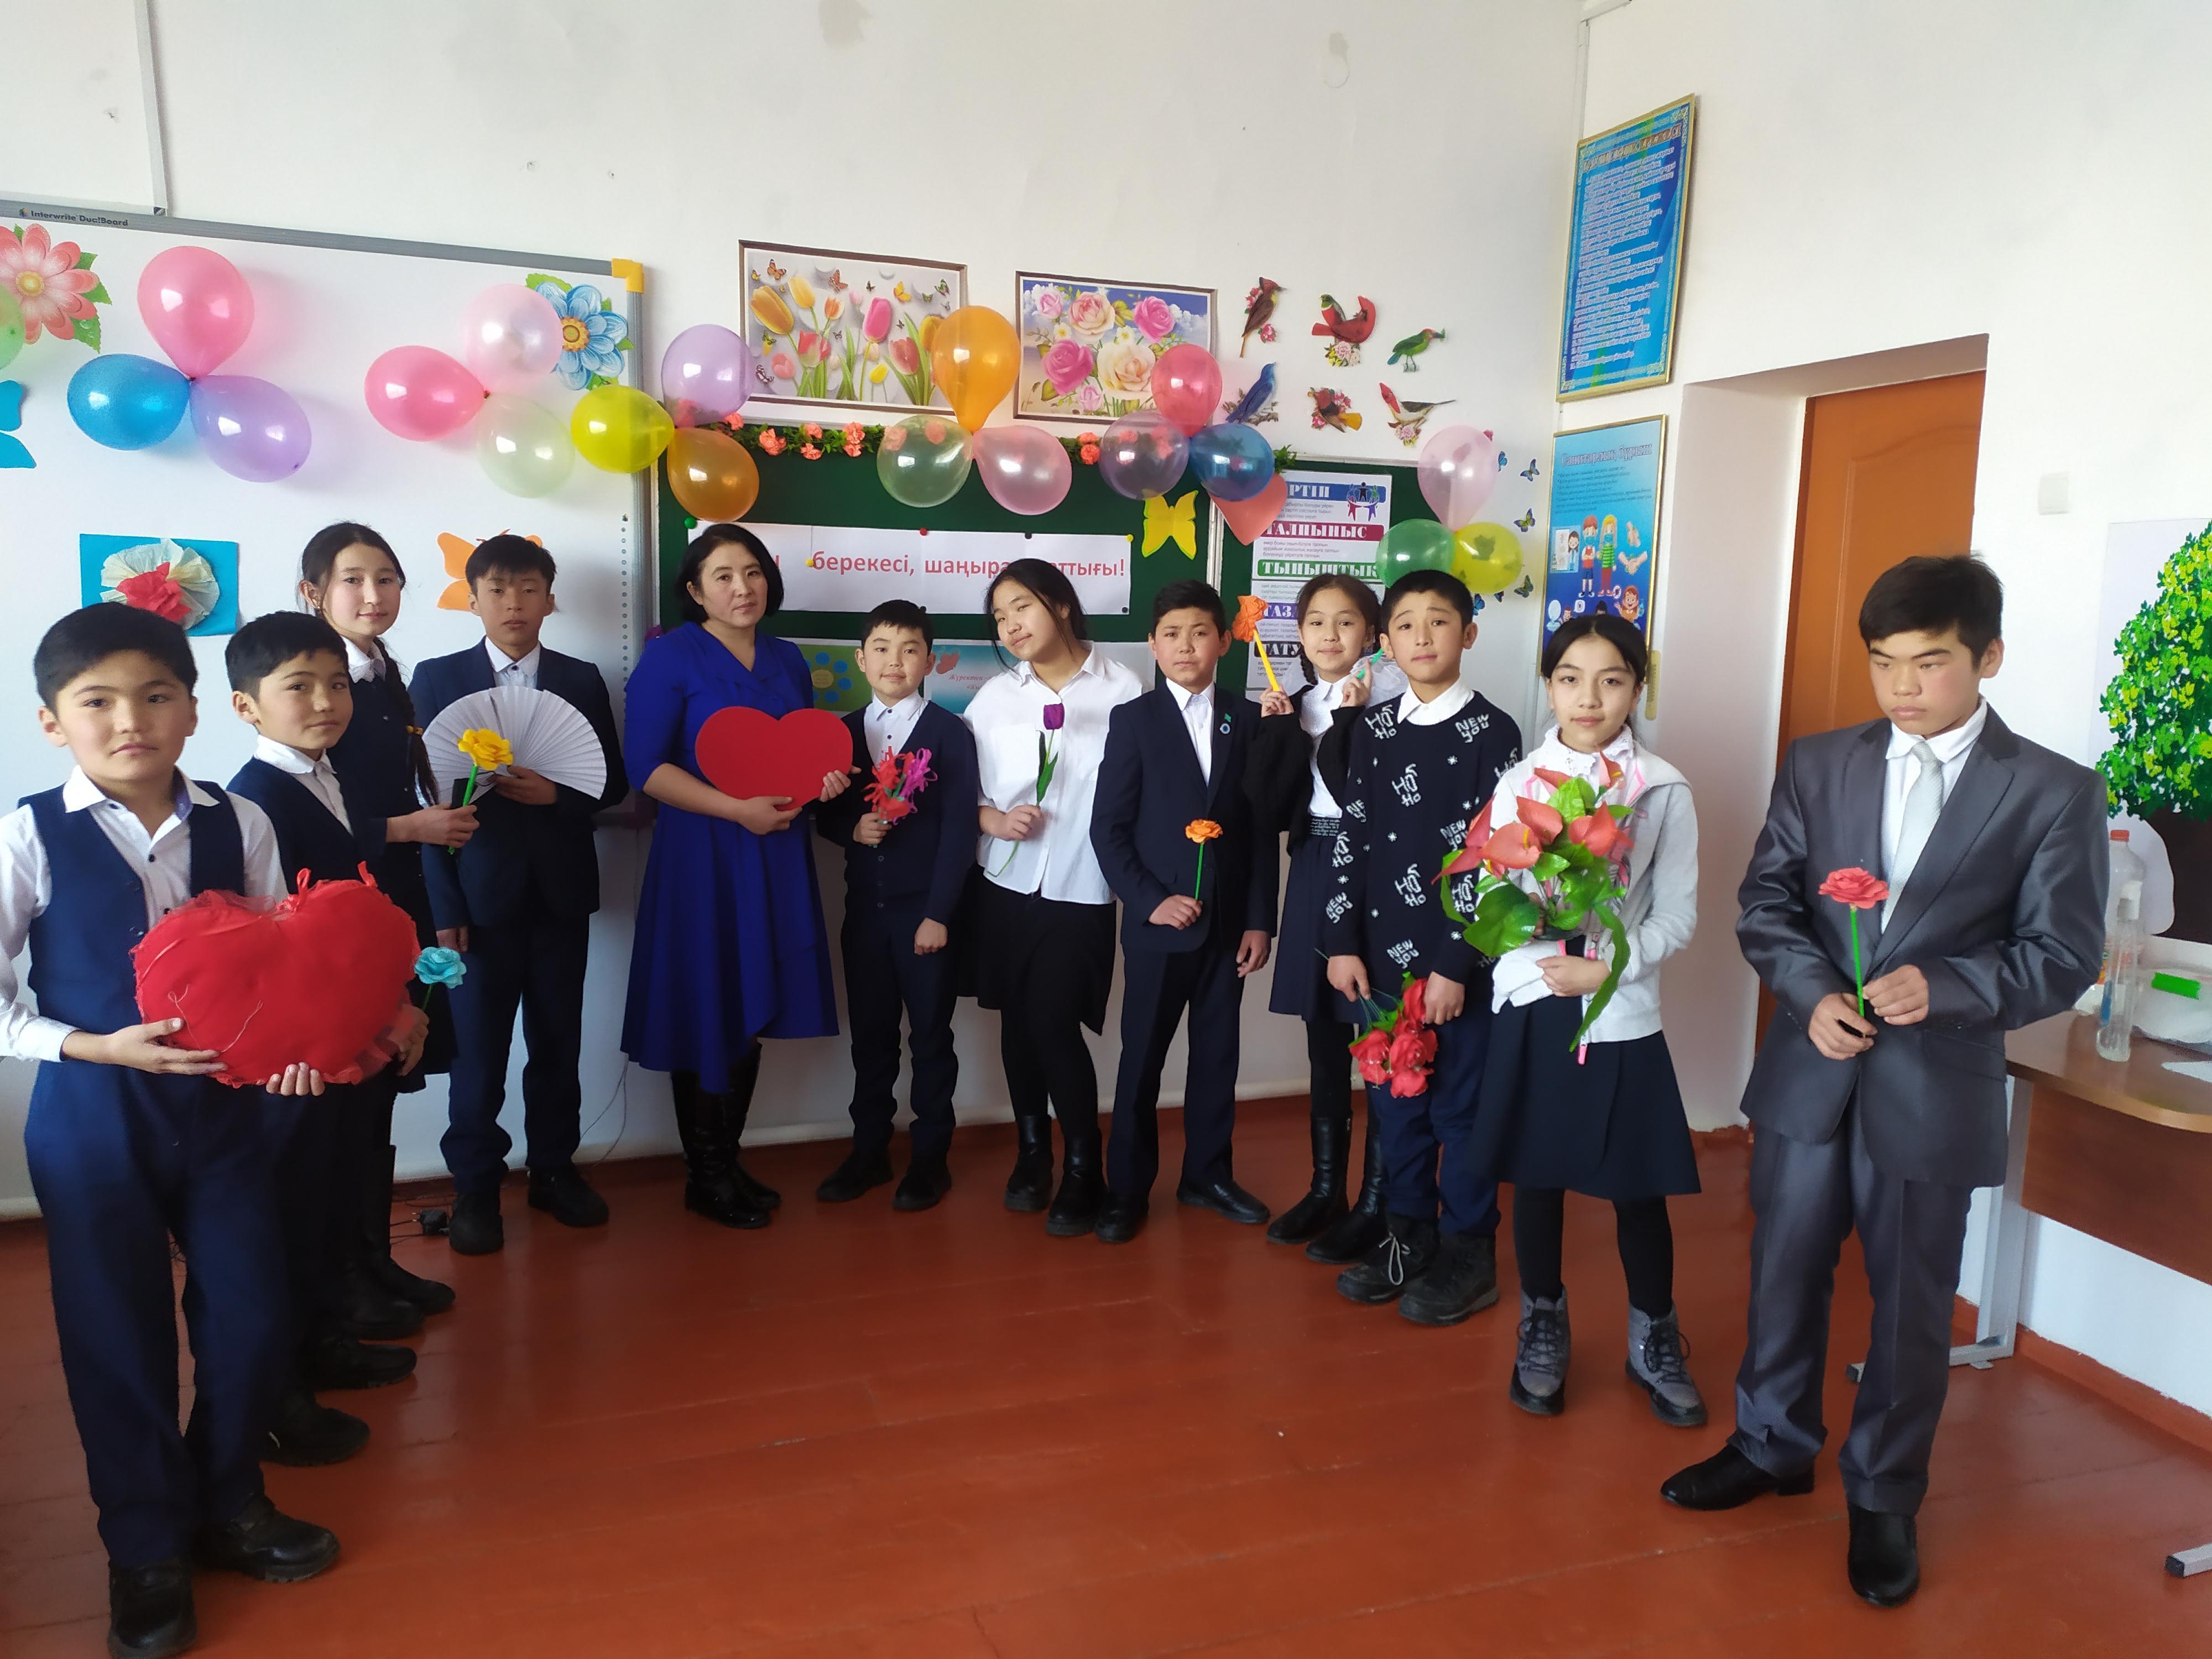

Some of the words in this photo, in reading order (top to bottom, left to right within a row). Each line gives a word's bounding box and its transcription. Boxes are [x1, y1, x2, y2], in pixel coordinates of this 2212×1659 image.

[31, 210, 76, 221] Interwrite
[812, 550, 915, 577] берекесі,
[925, 560, 1010, 579] шаңыра
[1049, 559, 1125, 577] ттығы!
[1455, 714, 1489, 732] NEW
